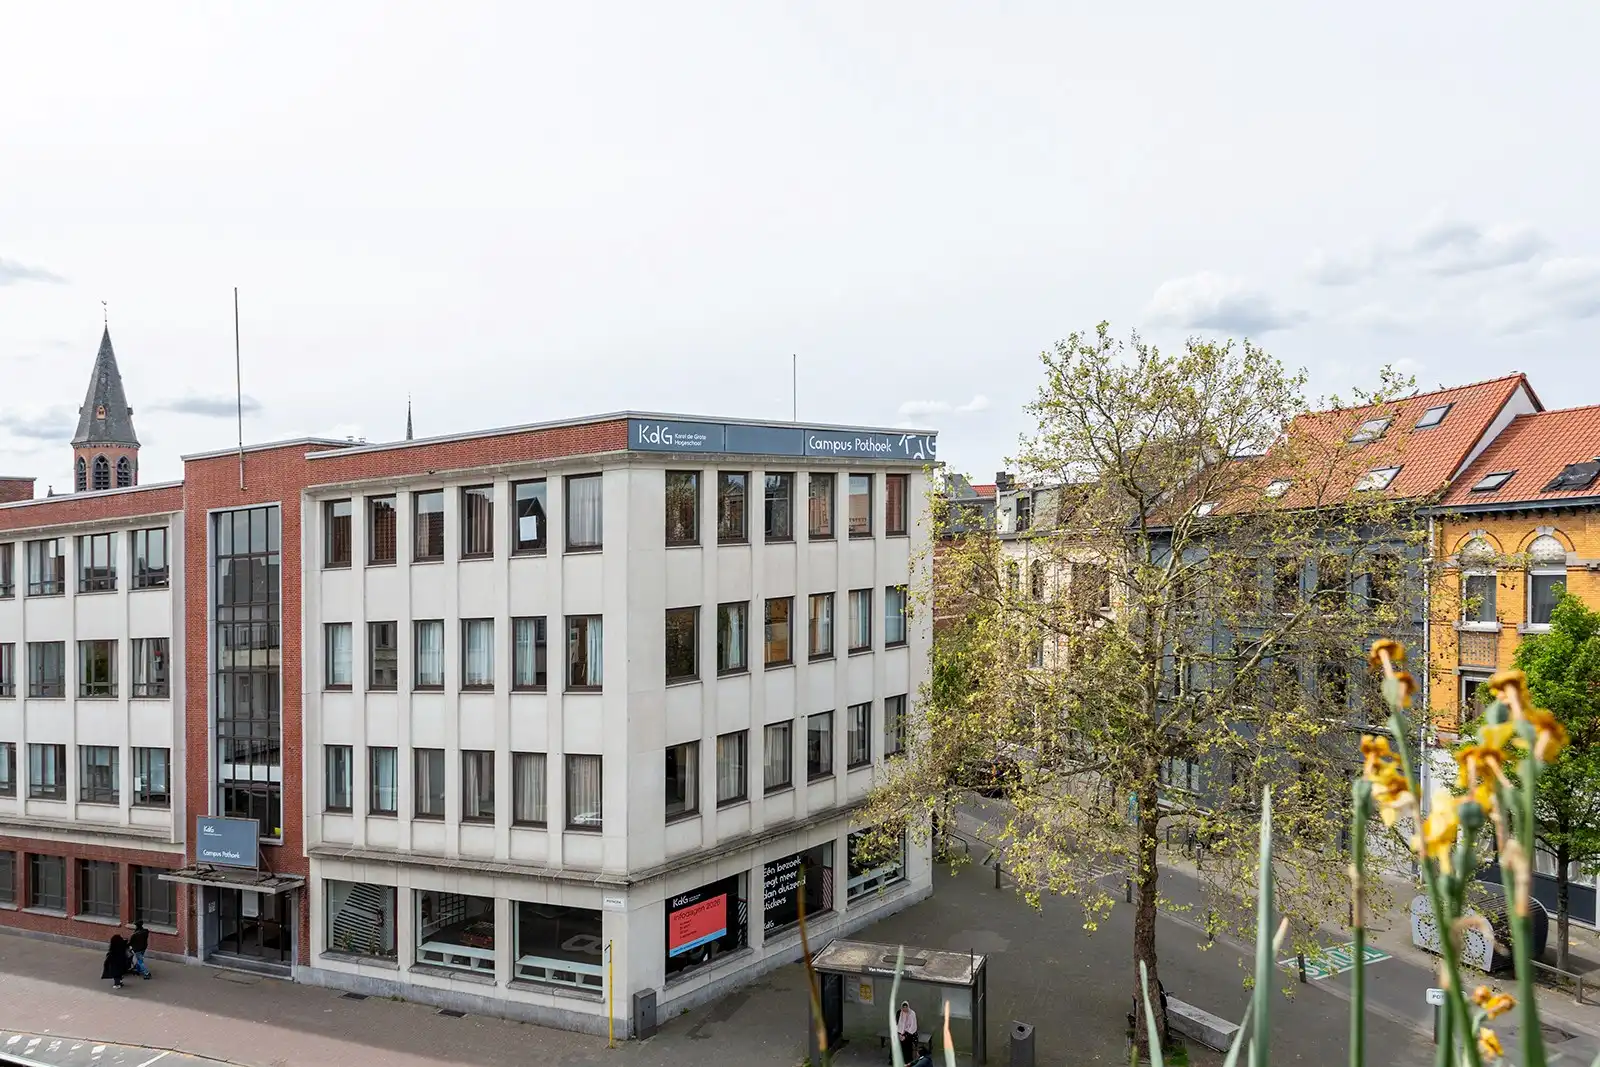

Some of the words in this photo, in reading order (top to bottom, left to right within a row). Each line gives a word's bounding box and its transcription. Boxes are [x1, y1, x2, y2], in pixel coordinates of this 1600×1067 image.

[639, 424, 672, 444] KdG
[809, 435, 852, 454] Campus
[855, 436, 892, 452] Pothoek
[203, 825, 215, 833] KdG
[203, 849, 221, 858] Campus
[222, 851, 240, 859] Pothoek
[777, 855, 802, 873] bezoek
[779, 870, 797, 882] meer
[778, 875, 806, 894] duizend
[672, 895, 689, 908] KdG
